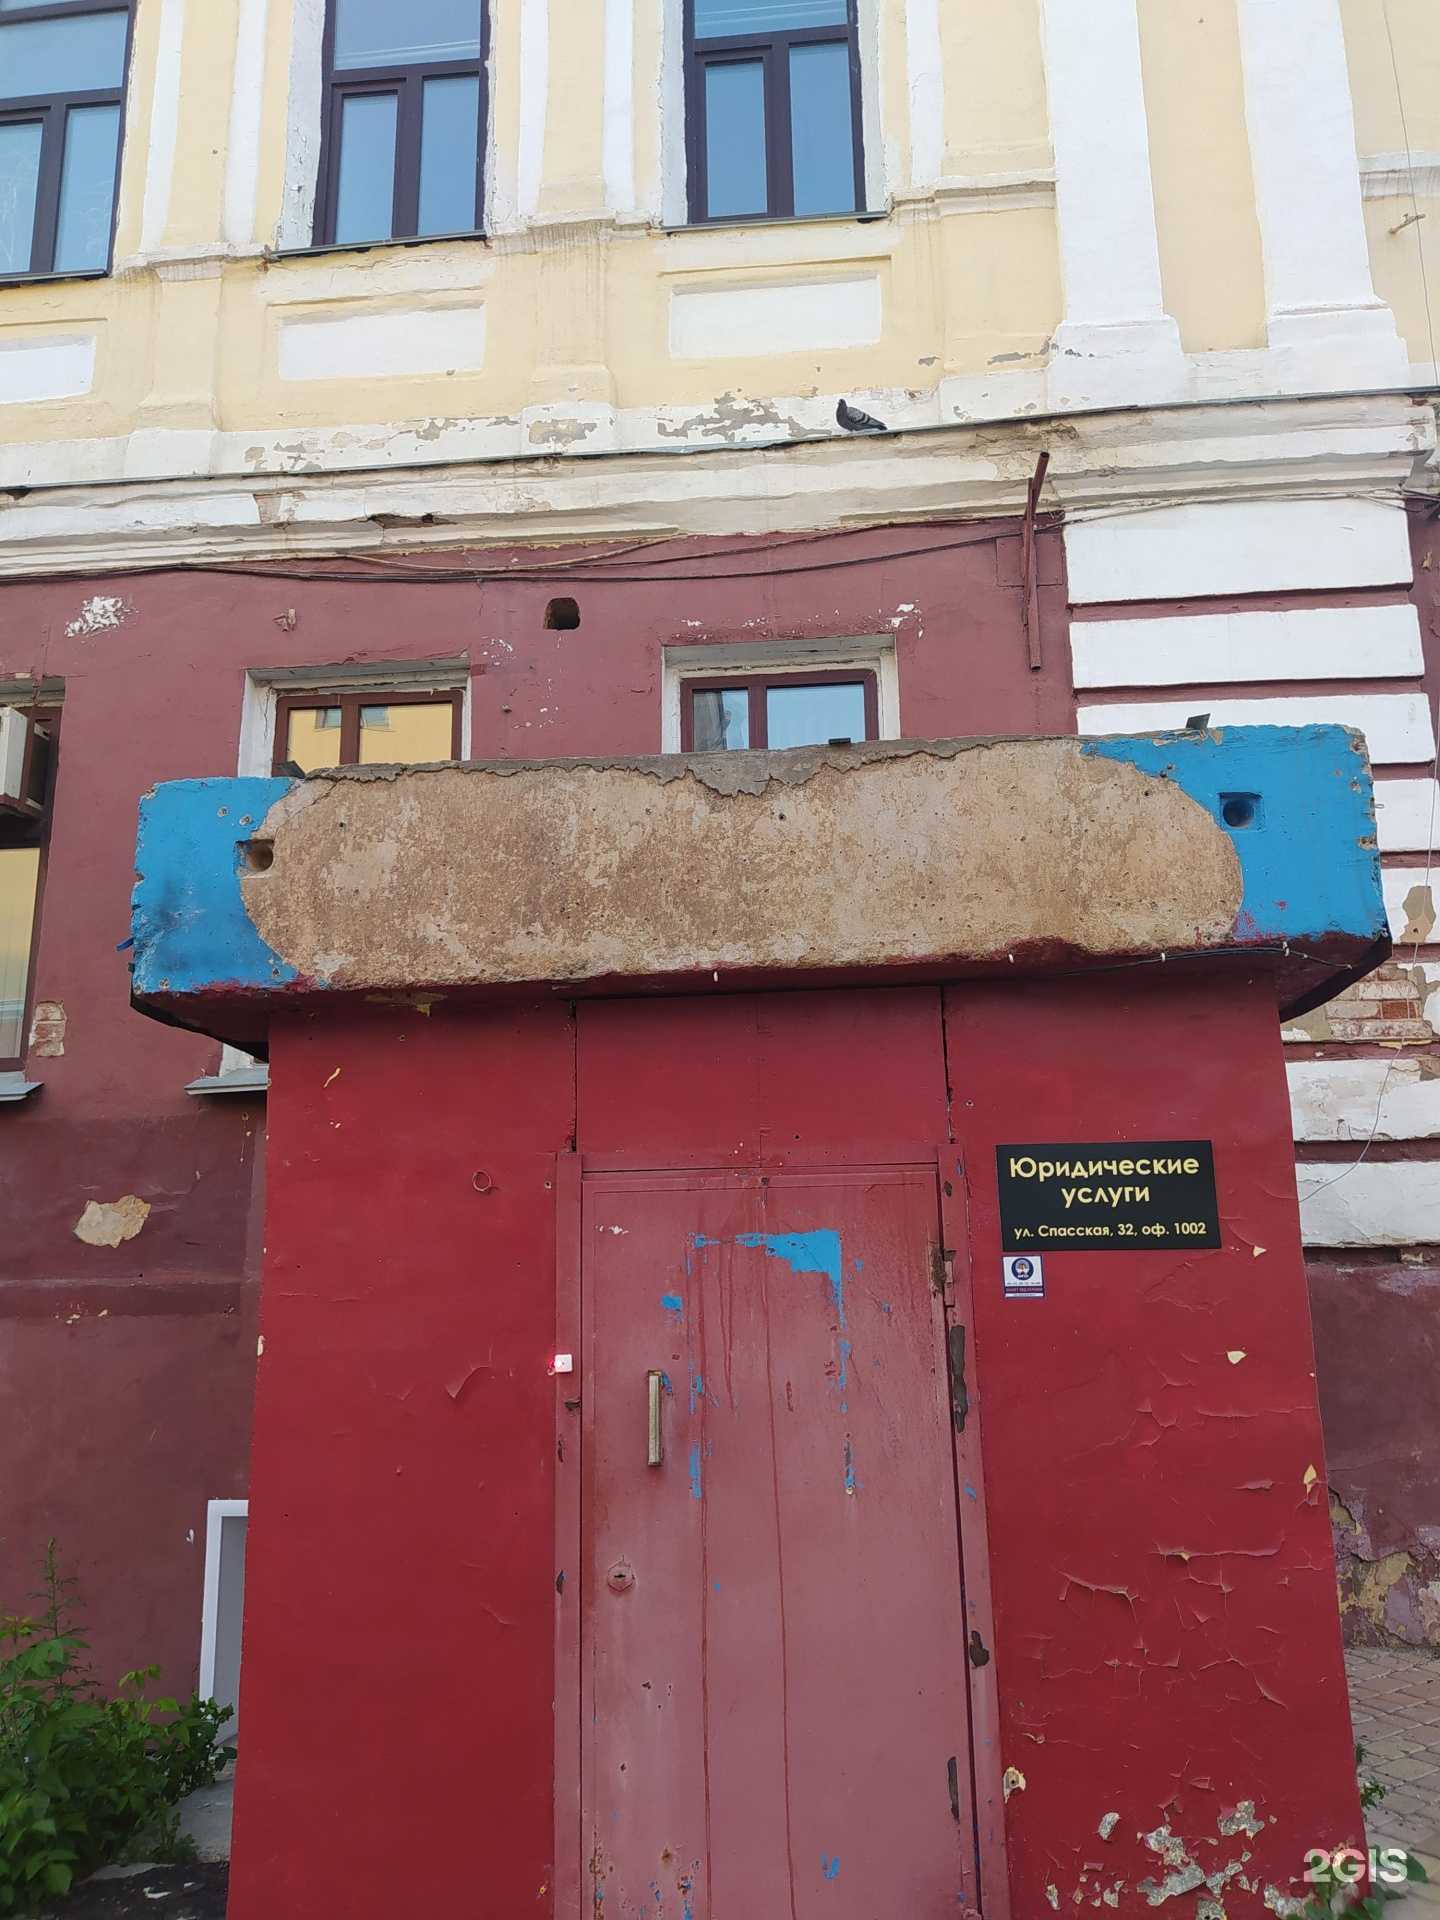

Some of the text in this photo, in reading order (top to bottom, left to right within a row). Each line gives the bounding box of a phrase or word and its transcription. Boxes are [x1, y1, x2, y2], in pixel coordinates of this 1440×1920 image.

[1009, 1156, 1200, 1182] Юридические
[1061, 1186, 1150, 1209] услуги
[1014, 1222, 1207, 1240] ул. Спасская, 32, оф. 1002
